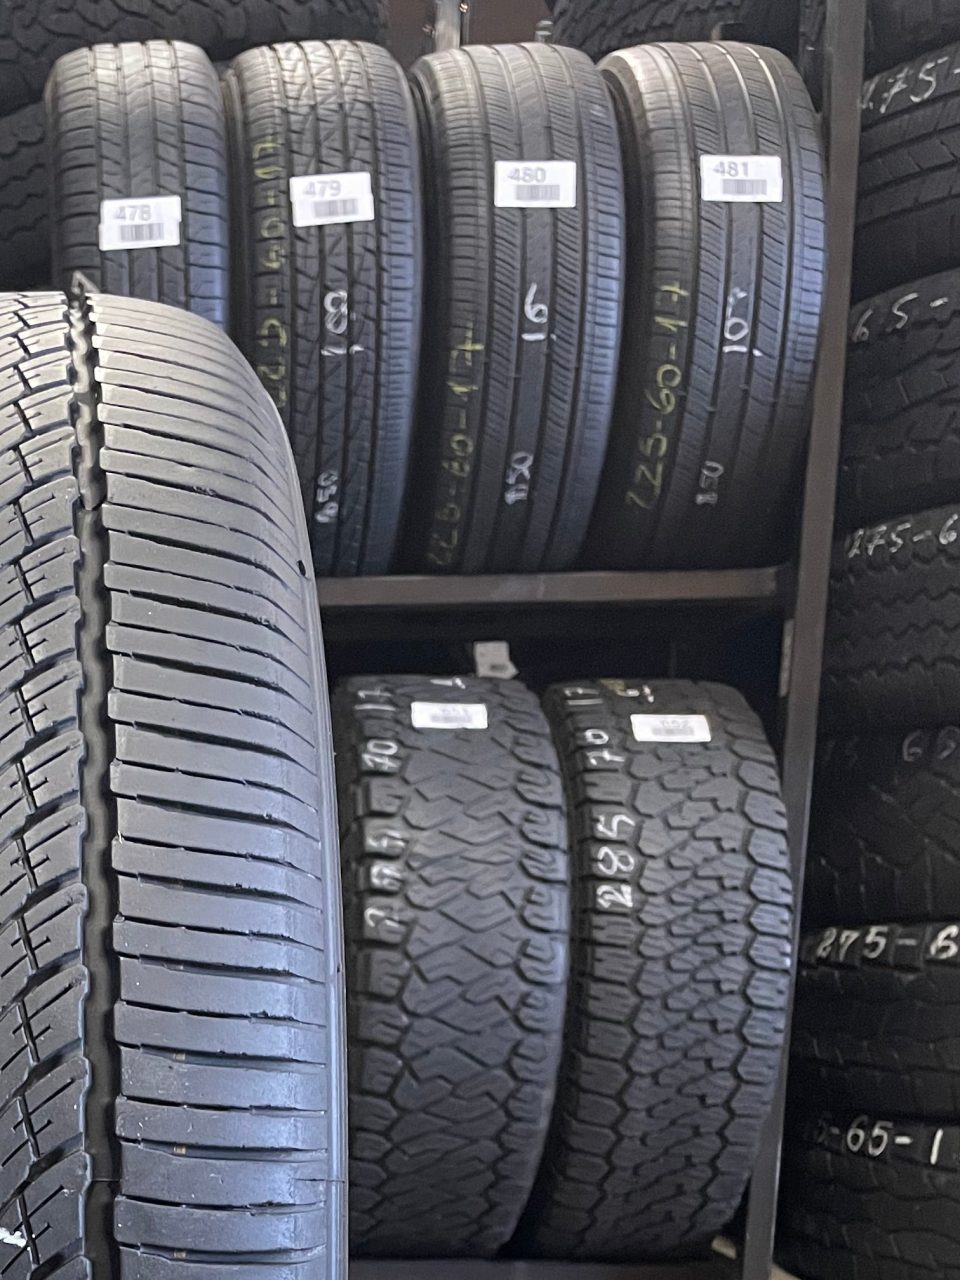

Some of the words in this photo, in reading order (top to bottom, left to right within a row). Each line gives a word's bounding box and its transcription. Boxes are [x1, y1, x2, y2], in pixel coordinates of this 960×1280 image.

[713, 160, 750, 178] 481
[303, 180, 342, 198] 479
[113, 204, 152, 222] 478
